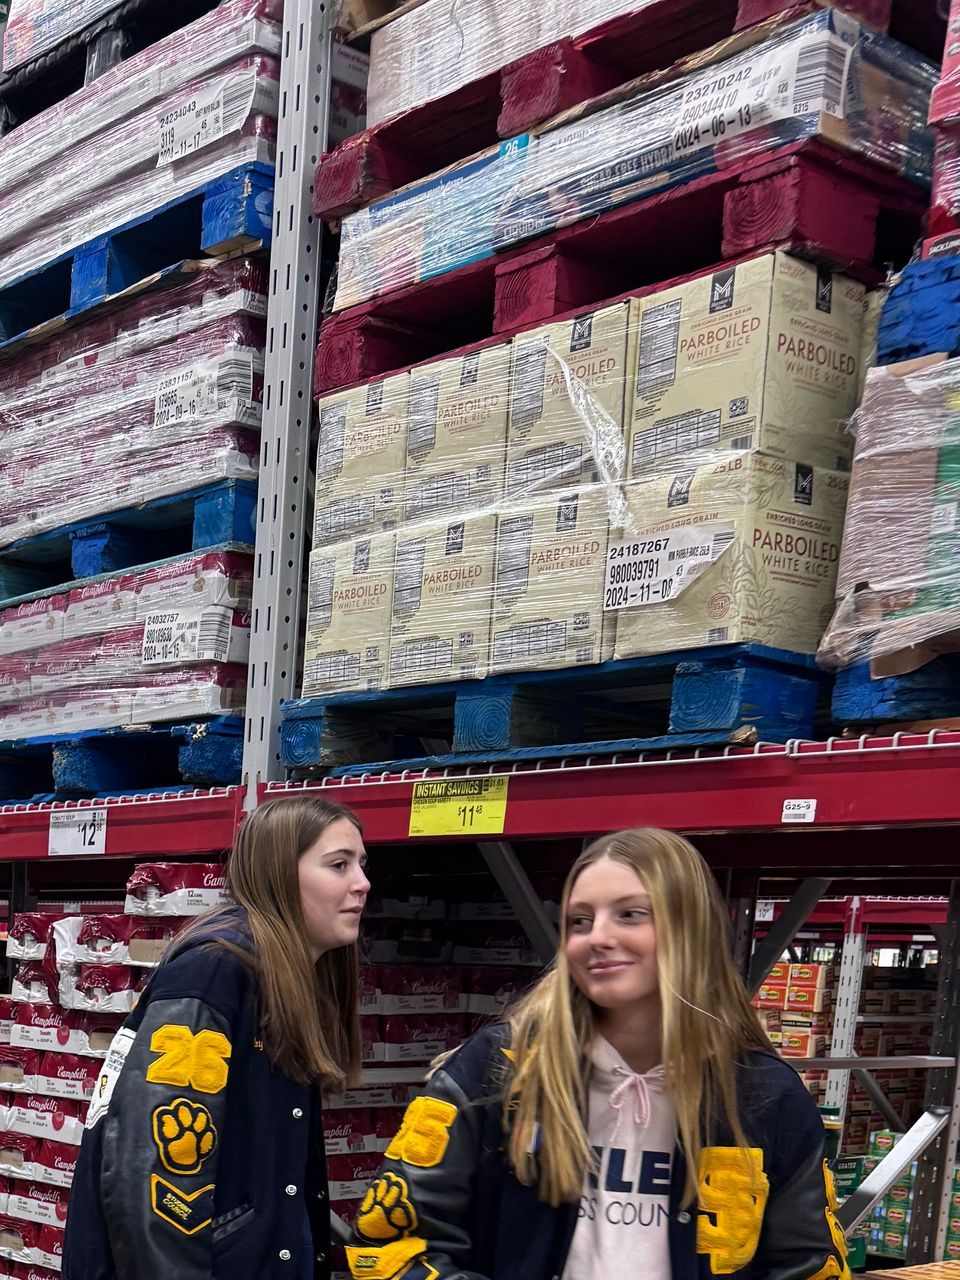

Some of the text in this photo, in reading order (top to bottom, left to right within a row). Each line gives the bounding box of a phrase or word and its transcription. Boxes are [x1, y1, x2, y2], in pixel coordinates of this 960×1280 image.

[685, 67, 751, 102] 23270242
[674, 105, 752, 151] 2024-06-13
[158, 132, 201, 166] 2024-11-17
[680, 317, 761, 353] PARBOILED
[688, 334, 751, 362] WHITE RICE
[777, 333, 856, 376] PARBOILED
[586, 374, 607, 387] RICE
[786, 361, 822, 383] WHITE
[438, 394, 499, 419] PARBOILED
[443, 410, 491, 429] WHITE RICE
[729, 458, 742, 472] LB
[694, 512, 719, 526] GRAIN
[531, 541, 600, 565] PARBOILED
[609, 538, 670, 559] 24187267
[753, 528, 839, 564] PARBOILED
[537, 555, 592, 573] WHITE RICE
[610, 558, 660, 585] 980039791
[762, 552, 830, 578] WHITE RICE
[423, 564, 483, 585] PARBOILED
[81, 579, 115, 599] Campbell's
[333, 583, 387, 602] PARBOILED
[428, 578, 475, 594] WHITE RICE
[606, 579, 674, 608] 2024-11-08
[17, 600, 48, 617] Campbell's
[338, 596, 381, 610] WHITE RICE
[147, 613, 180, 626] 24032757
[143, 643, 179, 661] 2024-10-15
[416, 780, 479, 798] INSTANT SAVINGS
[785, 803, 811, 811] G25-9
[30, 1012, 63, 1028] Campbell's
[57, 1066, 87, 1080] Campbell's
[28, 1097, 58, 1112] Campbell's
[29, 1186, 61, 1203] Campbell's
[165, 1192, 192, 1216] STUDENT
[162, 1197, 188, 1221] COUNCIL
